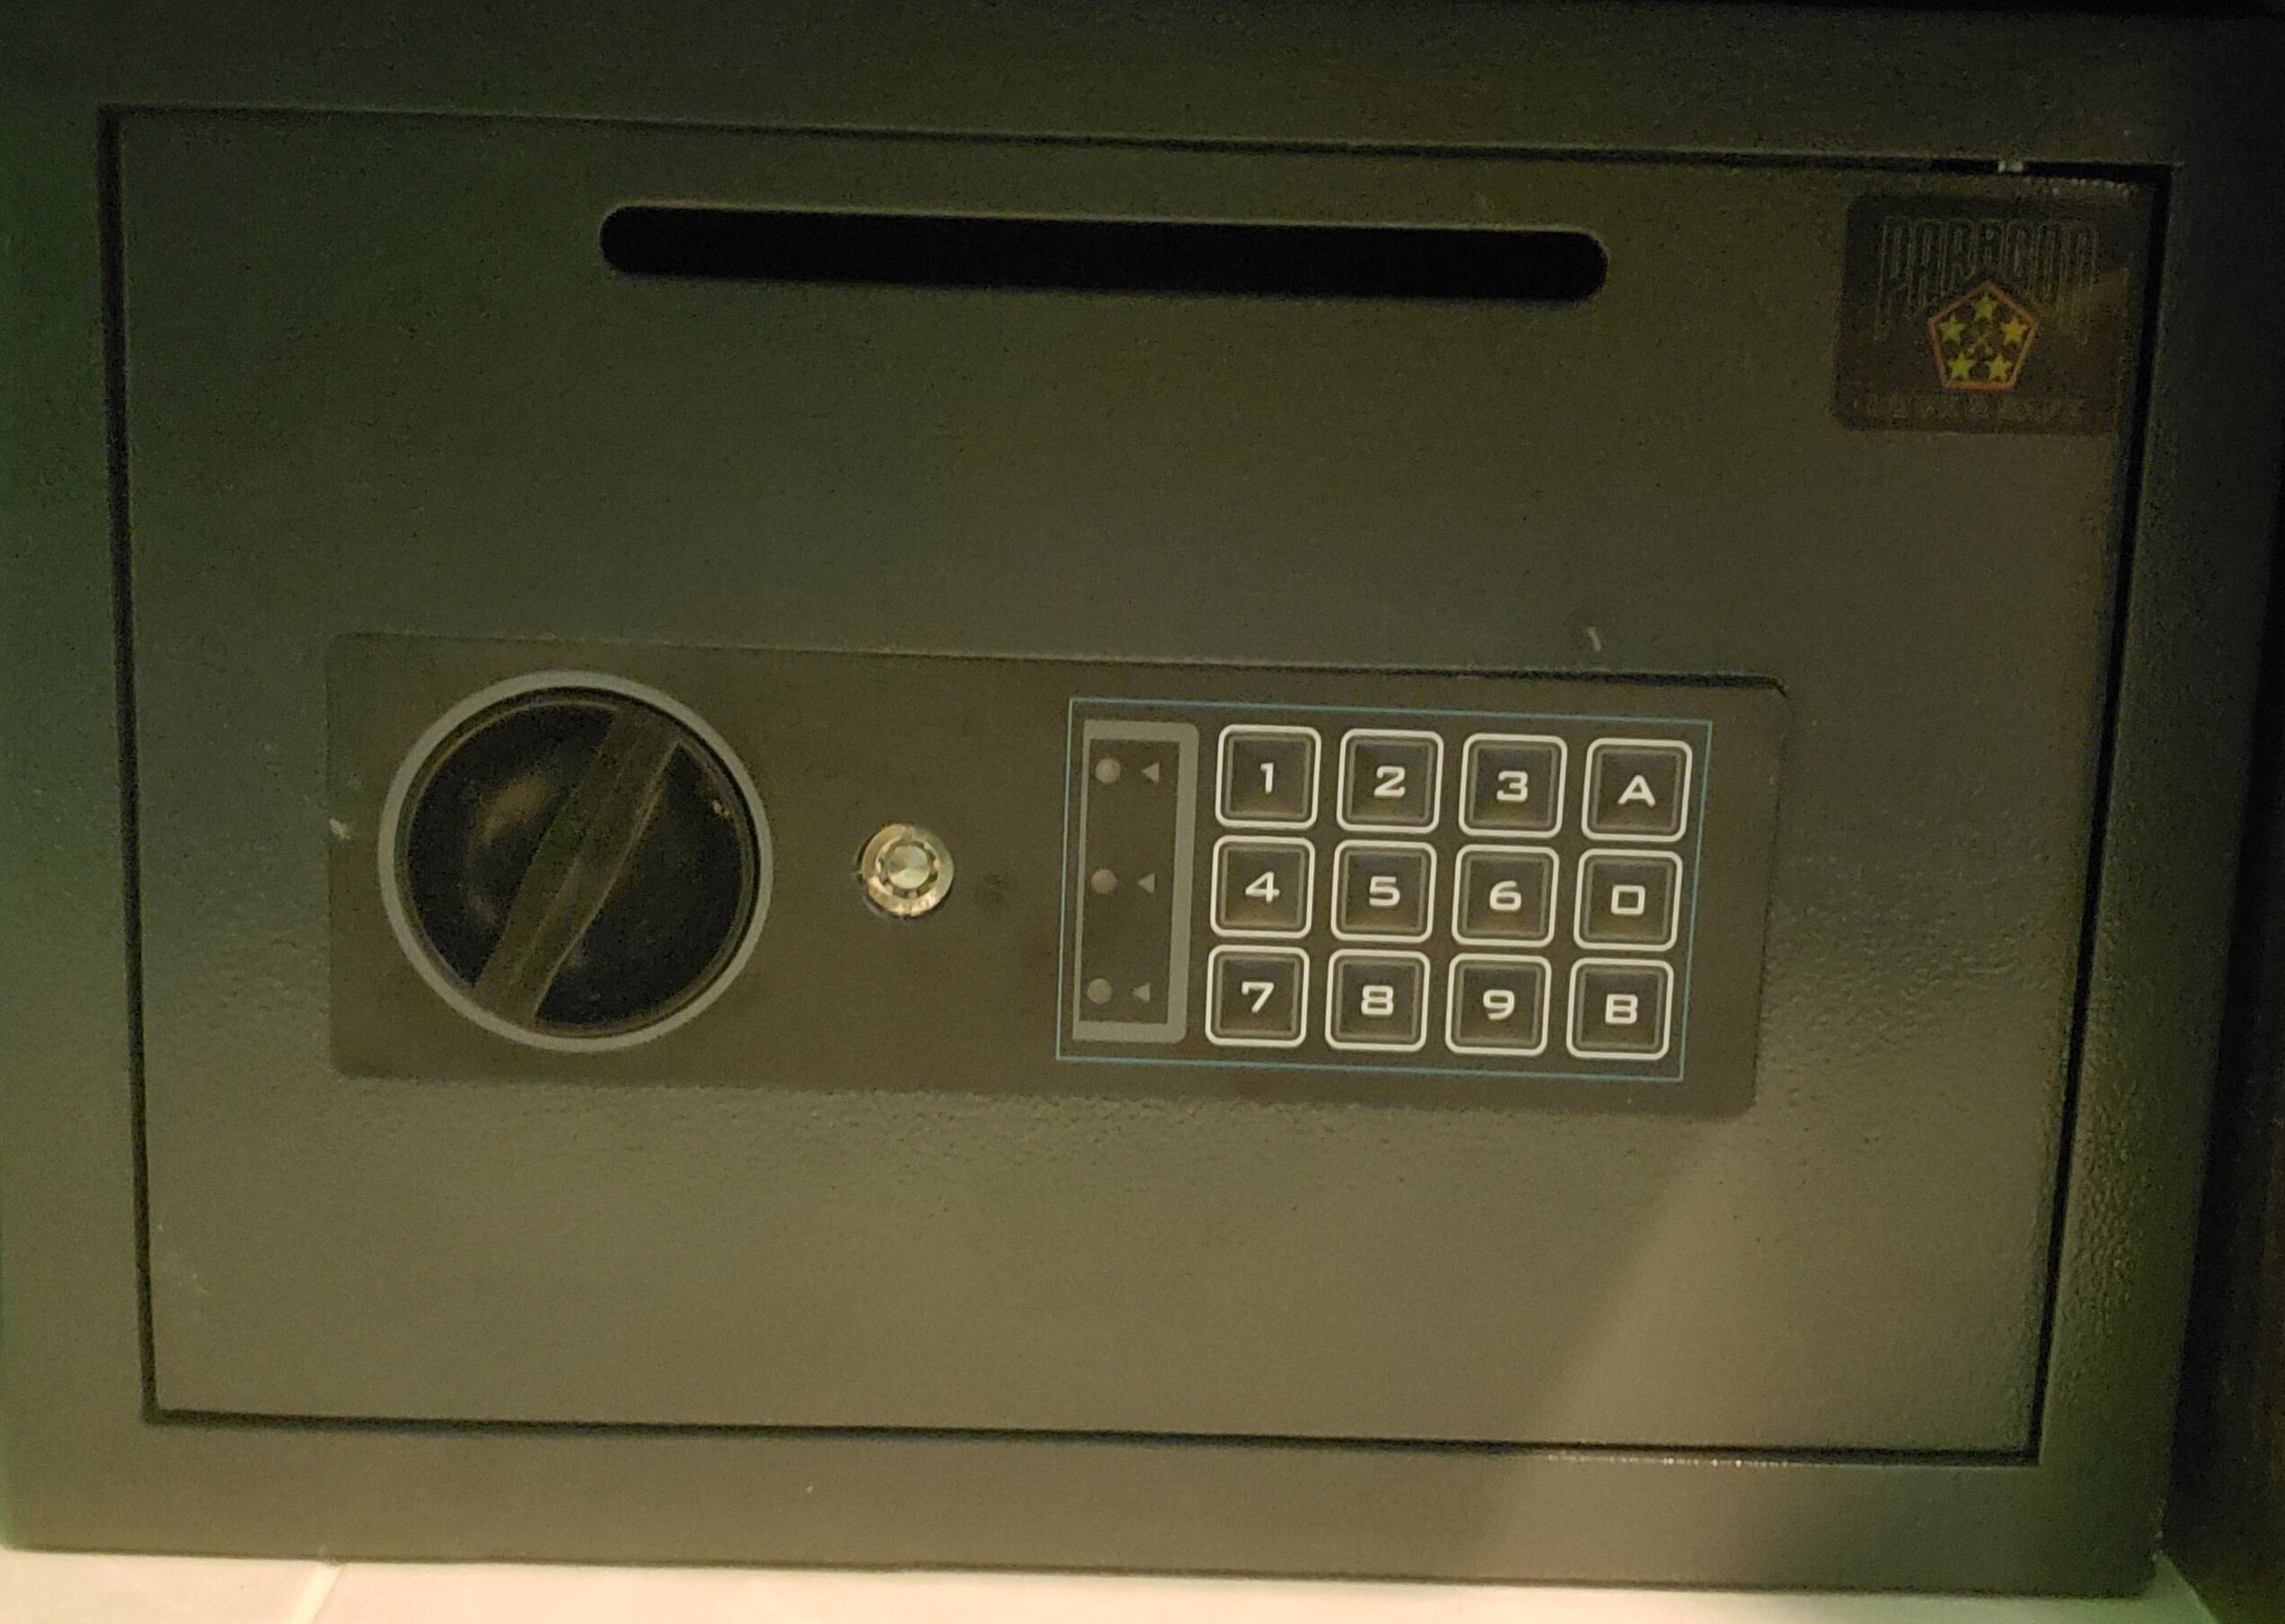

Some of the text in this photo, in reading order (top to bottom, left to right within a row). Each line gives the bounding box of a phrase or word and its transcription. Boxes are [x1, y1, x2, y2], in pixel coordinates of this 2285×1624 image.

[1260, 763, 1656, 807] 1 2 3 A
[1245, 871, 1646, 916] 4 5 6 0
[1241, 982, 1638, 1025] 7 8 9 B
